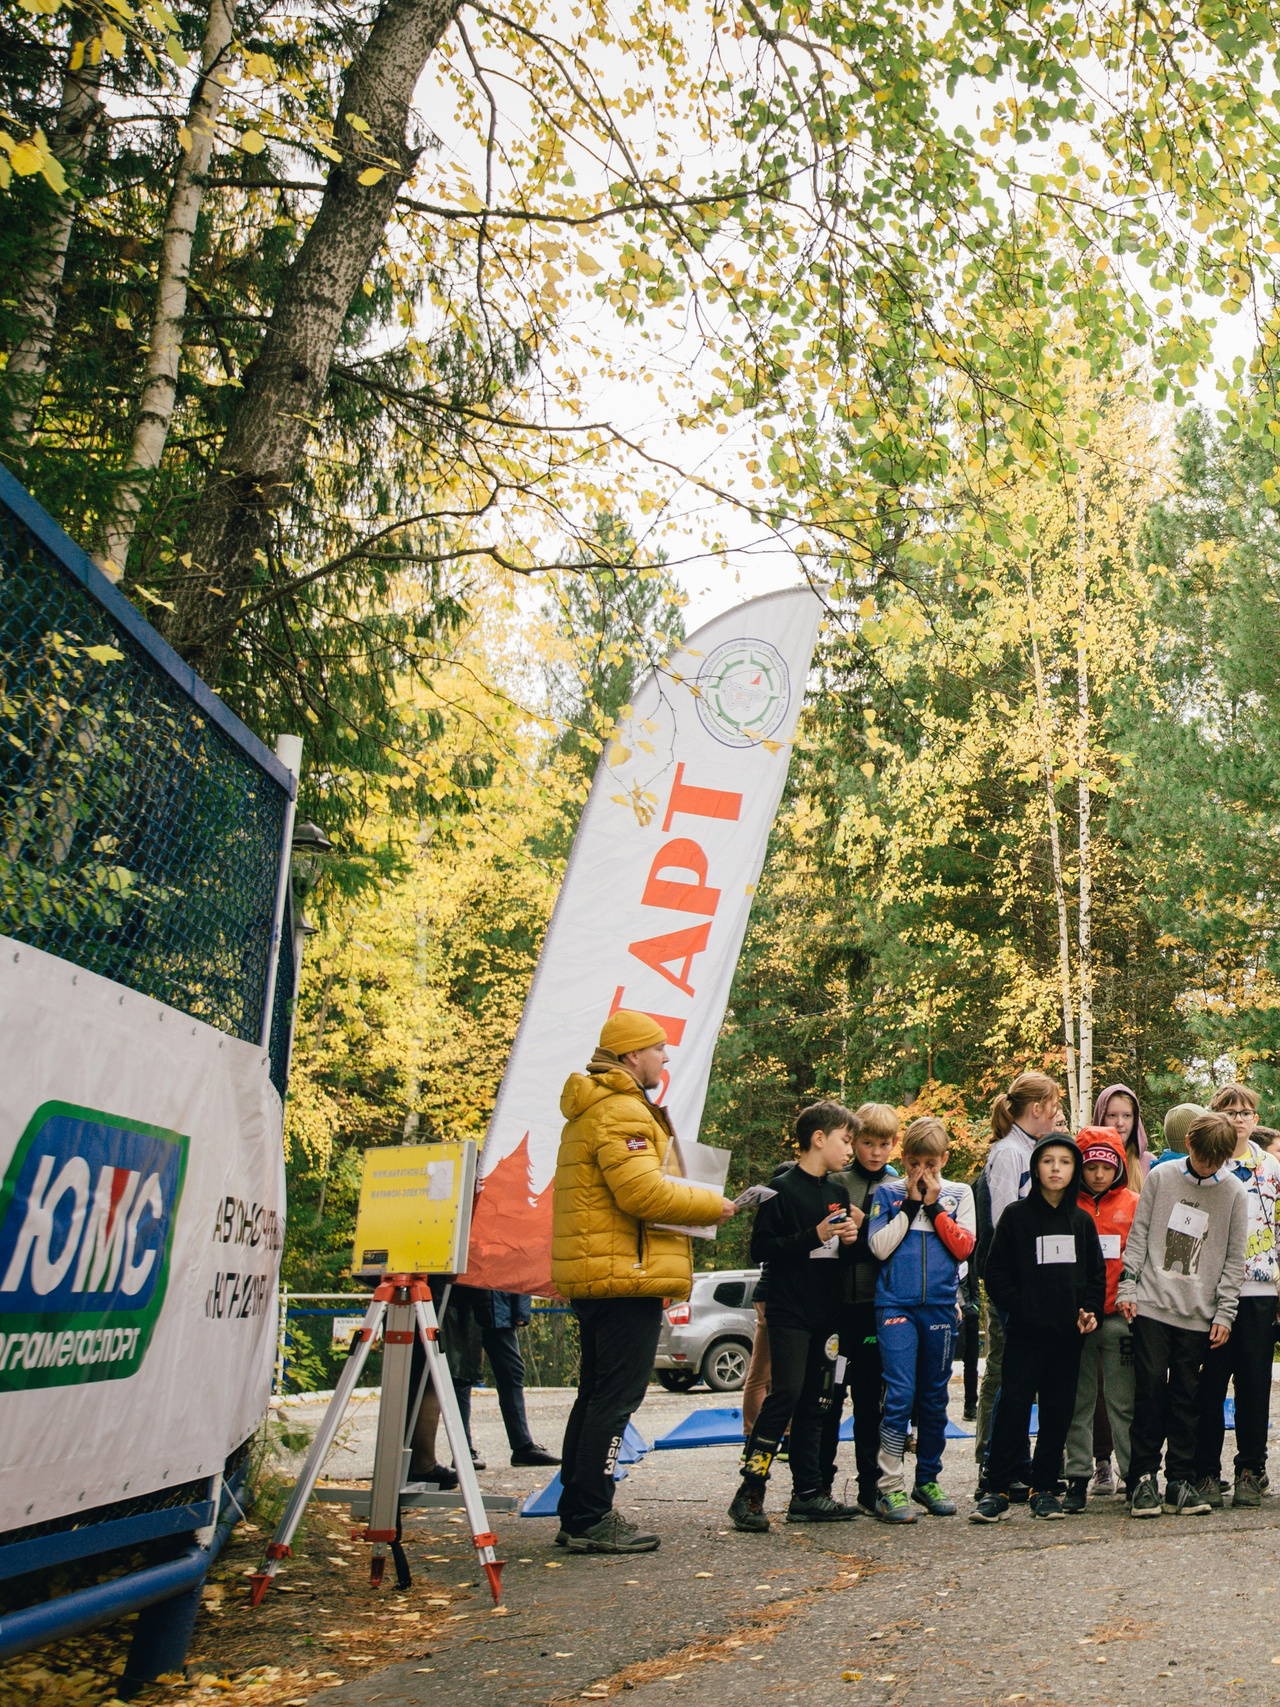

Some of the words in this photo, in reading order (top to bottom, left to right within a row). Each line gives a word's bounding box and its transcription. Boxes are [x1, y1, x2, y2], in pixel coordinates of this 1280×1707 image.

[607, 762, 743, 1105] ТАРТ
[1184, 1216, 1192, 1225] 8
[0, 1154, 163, 1296] ЮМС
[1056, 1246, 1060, 1254] 1
[930, 1323, 951, 1331] ЮГРА
[863, 1336, 878, 1344] FIL
